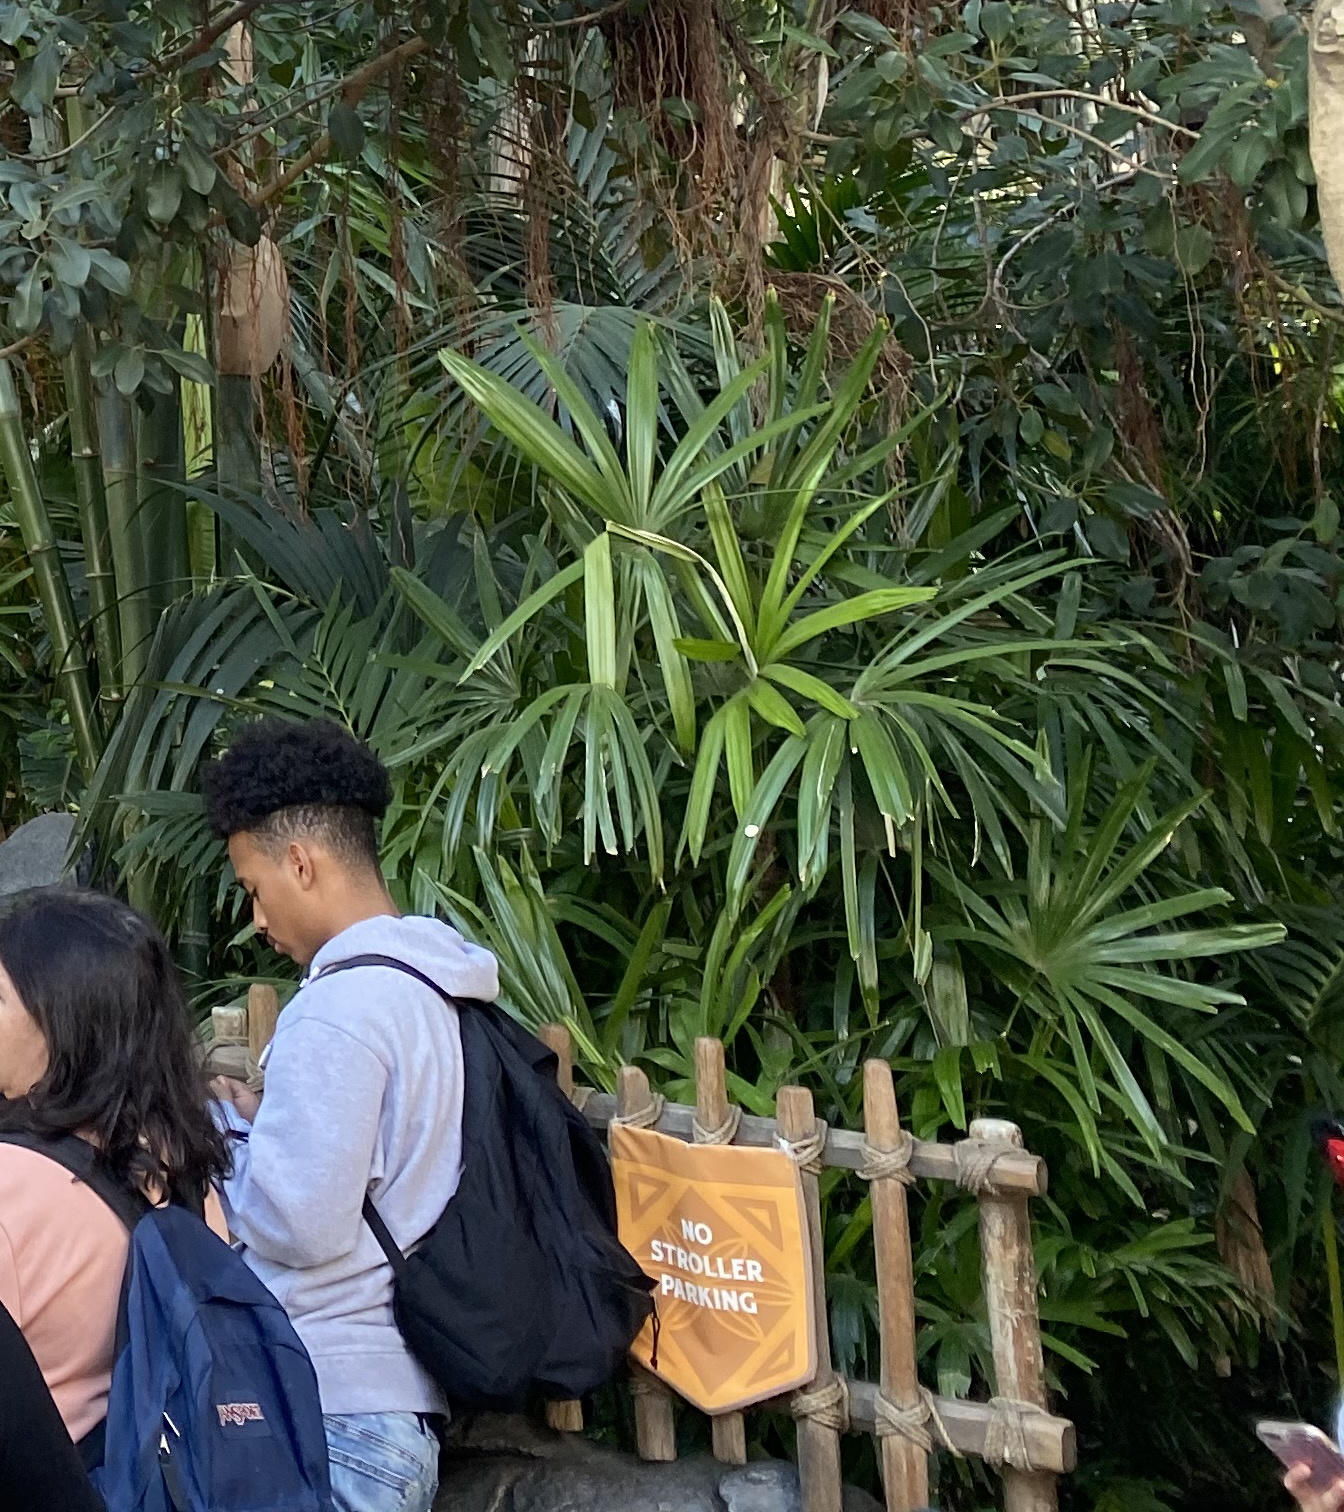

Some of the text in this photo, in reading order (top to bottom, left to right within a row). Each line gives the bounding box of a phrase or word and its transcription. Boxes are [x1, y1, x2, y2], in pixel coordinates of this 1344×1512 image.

[680, 1218, 713, 1246] NO
[650, 1239, 764, 1283] STROLLER
[661, 1274, 758, 1314] PARKING
